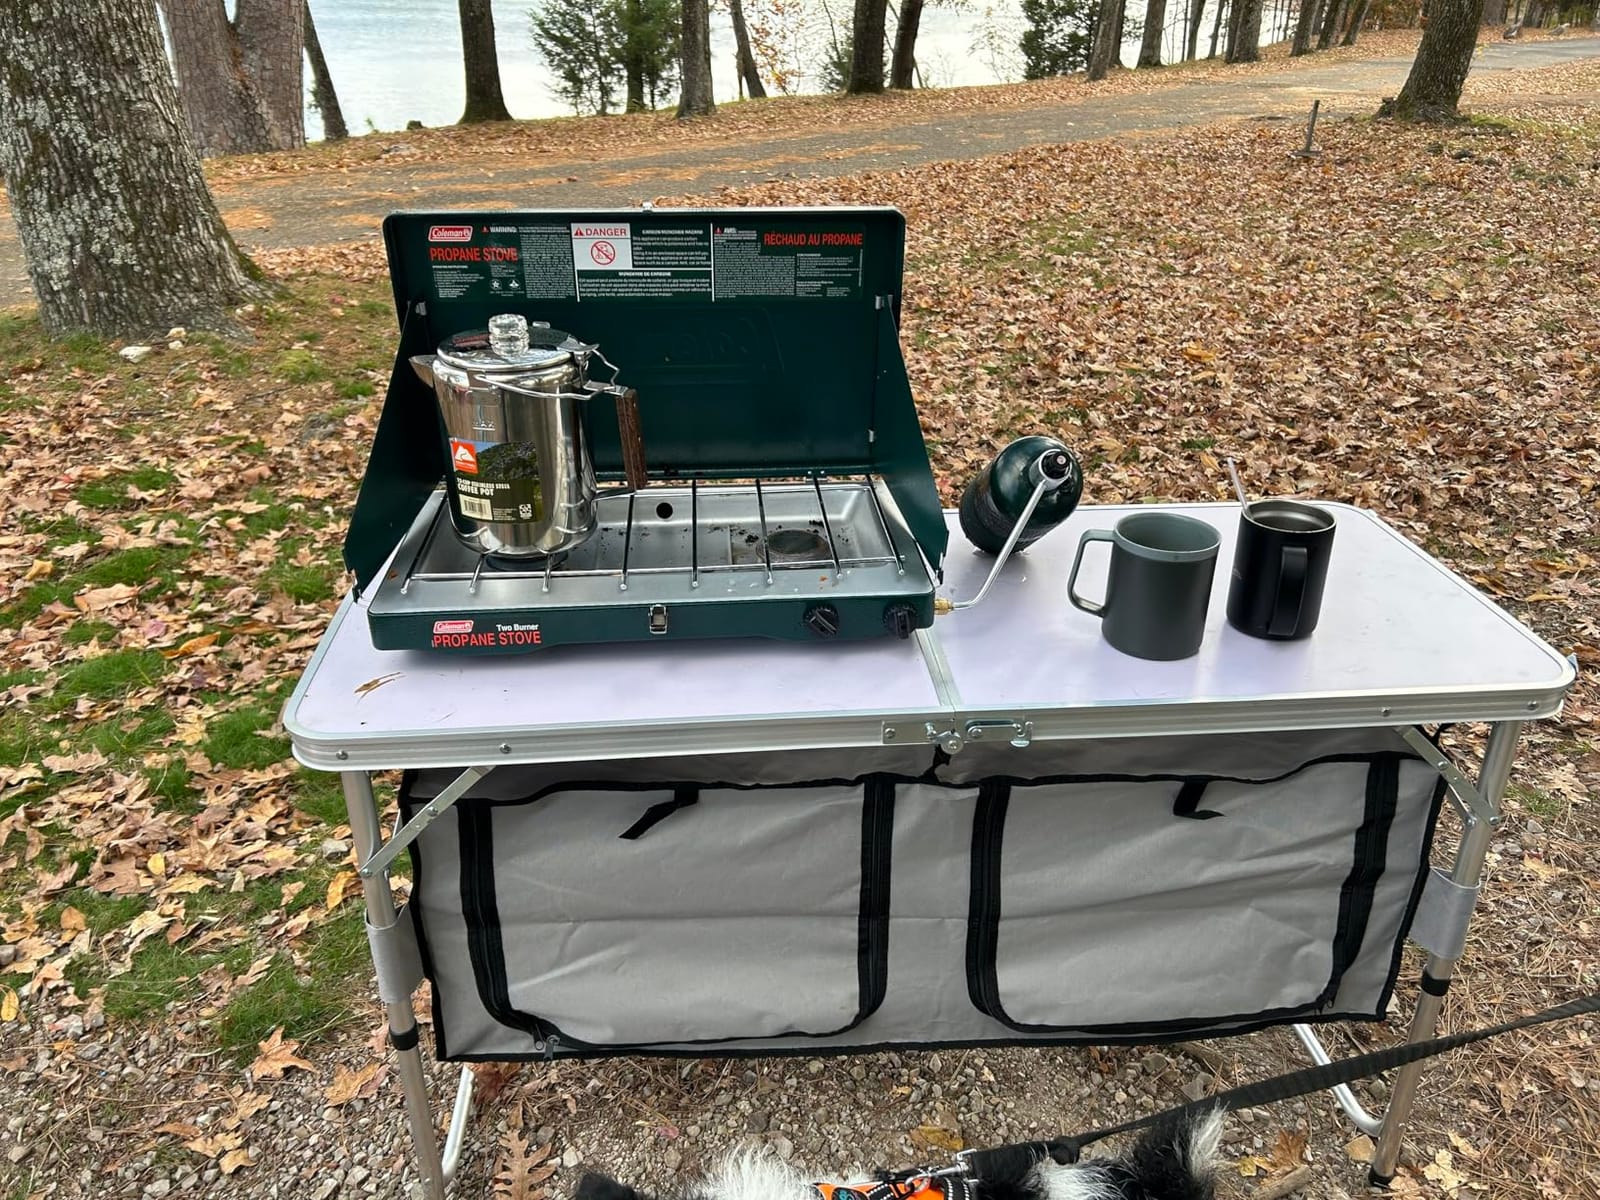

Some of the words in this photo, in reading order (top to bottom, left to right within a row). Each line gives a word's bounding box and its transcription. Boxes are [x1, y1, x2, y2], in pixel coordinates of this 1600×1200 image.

[432, 228, 463, 237] Coleman
[585, 228, 626, 236] DANGER
[764, 231, 806, 246] RÉCHAUD
[808, 233, 820, 245] AU
[822, 233, 863, 245] PROPANE
[430, 248, 480, 261] PROPANE
[483, 248, 518, 261] STOVE
[458, 483, 479, 494] COFFEE
[480, 488, 494, 496] POT
[433, 632, 496, 648] PROPANE
[498, 632, 542, 645] STOVE
